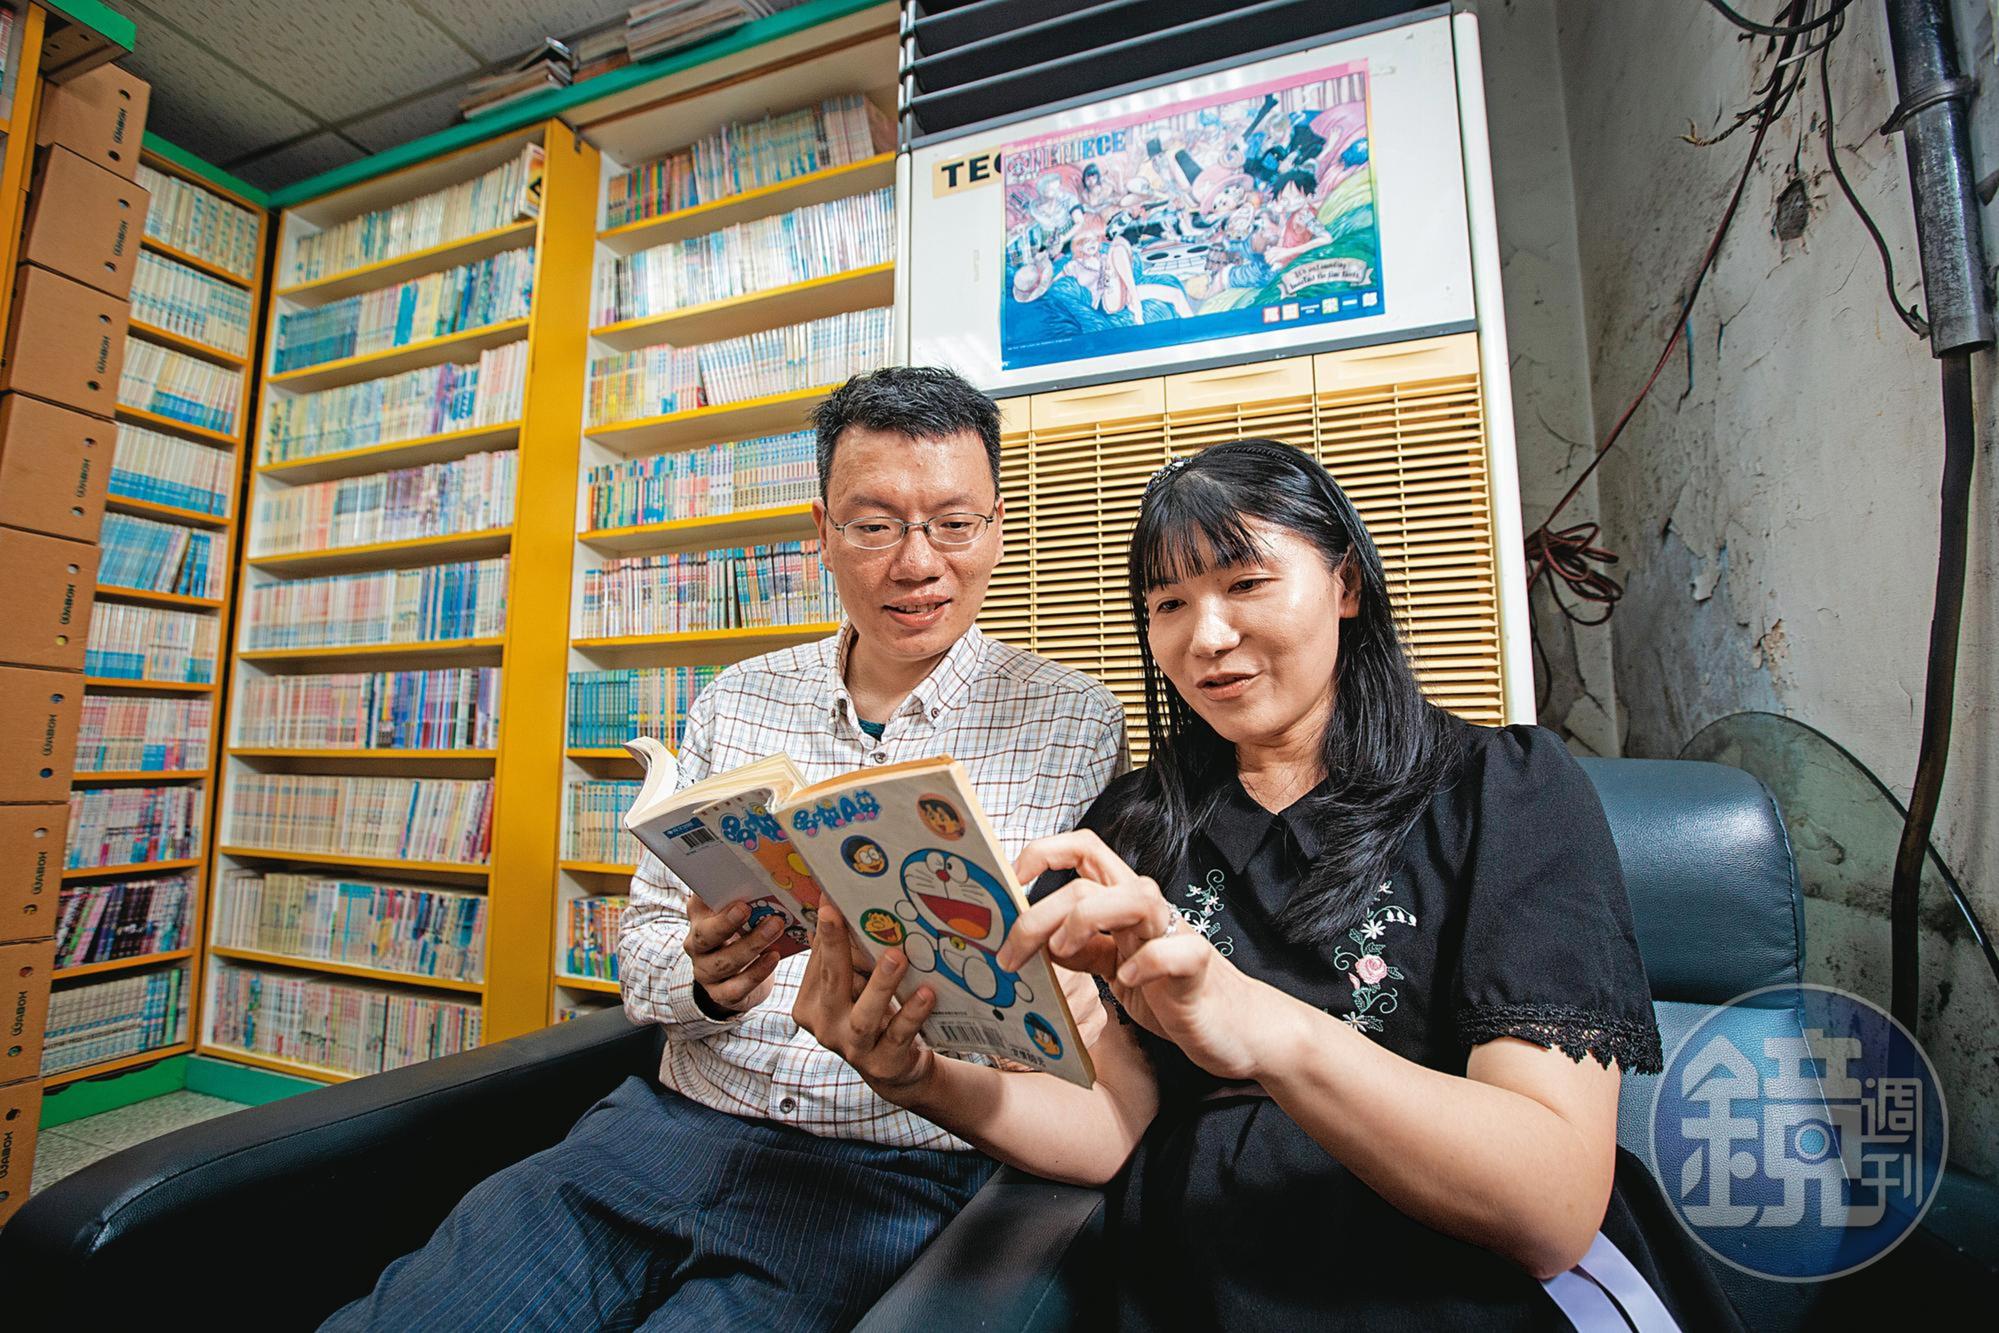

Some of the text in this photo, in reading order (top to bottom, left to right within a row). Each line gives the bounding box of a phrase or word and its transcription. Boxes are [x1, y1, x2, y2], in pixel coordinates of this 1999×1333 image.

[59, 583, 76, 625] WABOX
[42, 713, 58, 757] WABOX
[32, 851, 48, 895] WABOX
[11, 990, 28, 1036] WABOX
